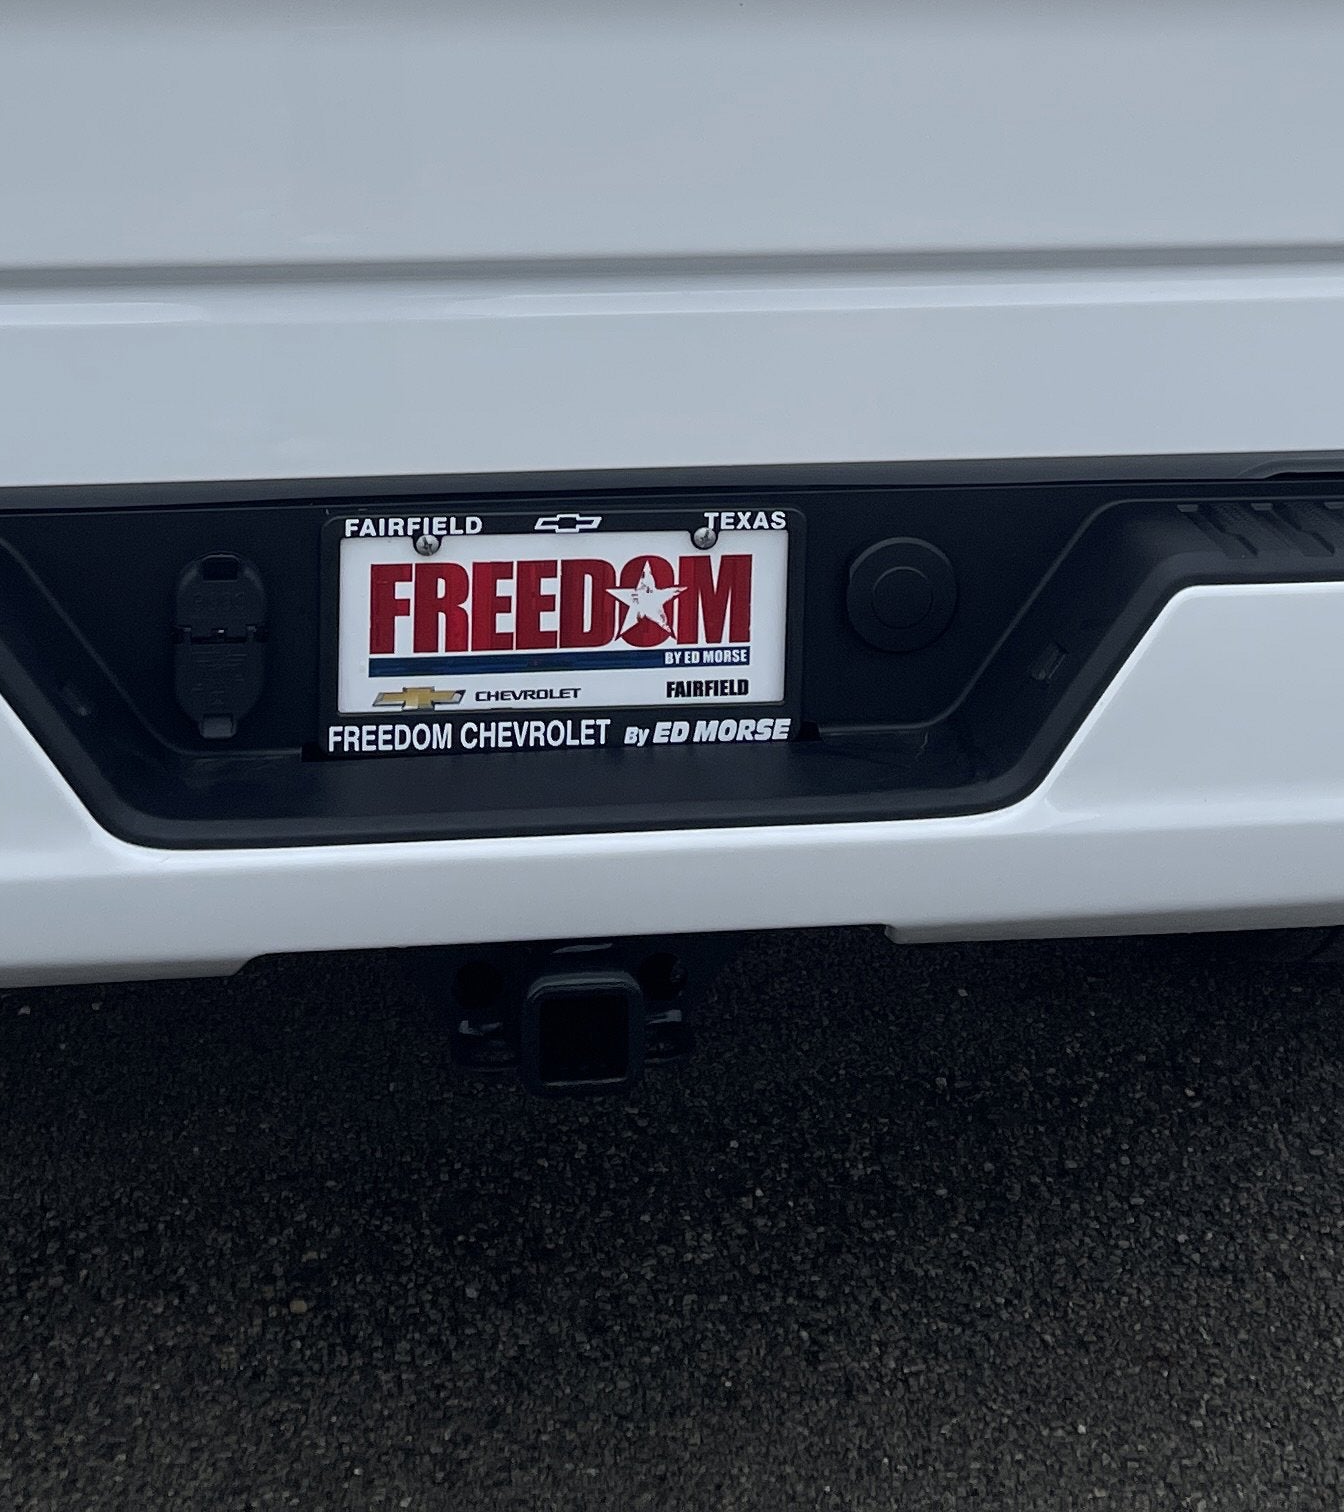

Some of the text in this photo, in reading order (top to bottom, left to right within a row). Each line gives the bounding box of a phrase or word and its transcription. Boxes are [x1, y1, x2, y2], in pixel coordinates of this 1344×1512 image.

[344, 516, 483, 538] FAIRFIELD
[704, 510, 787, 531] TEXAS
[369, 554, 753, 655] FREEDOM
[664, 648, 748, 665] BY ED MORSE
[475, 688, 582, 702] CHEVROLET
[666, 678, 750, 698] FAIRFIELD
[328, 718, 792, 752] FREEDOM CHEVROLET By ED MORSE
